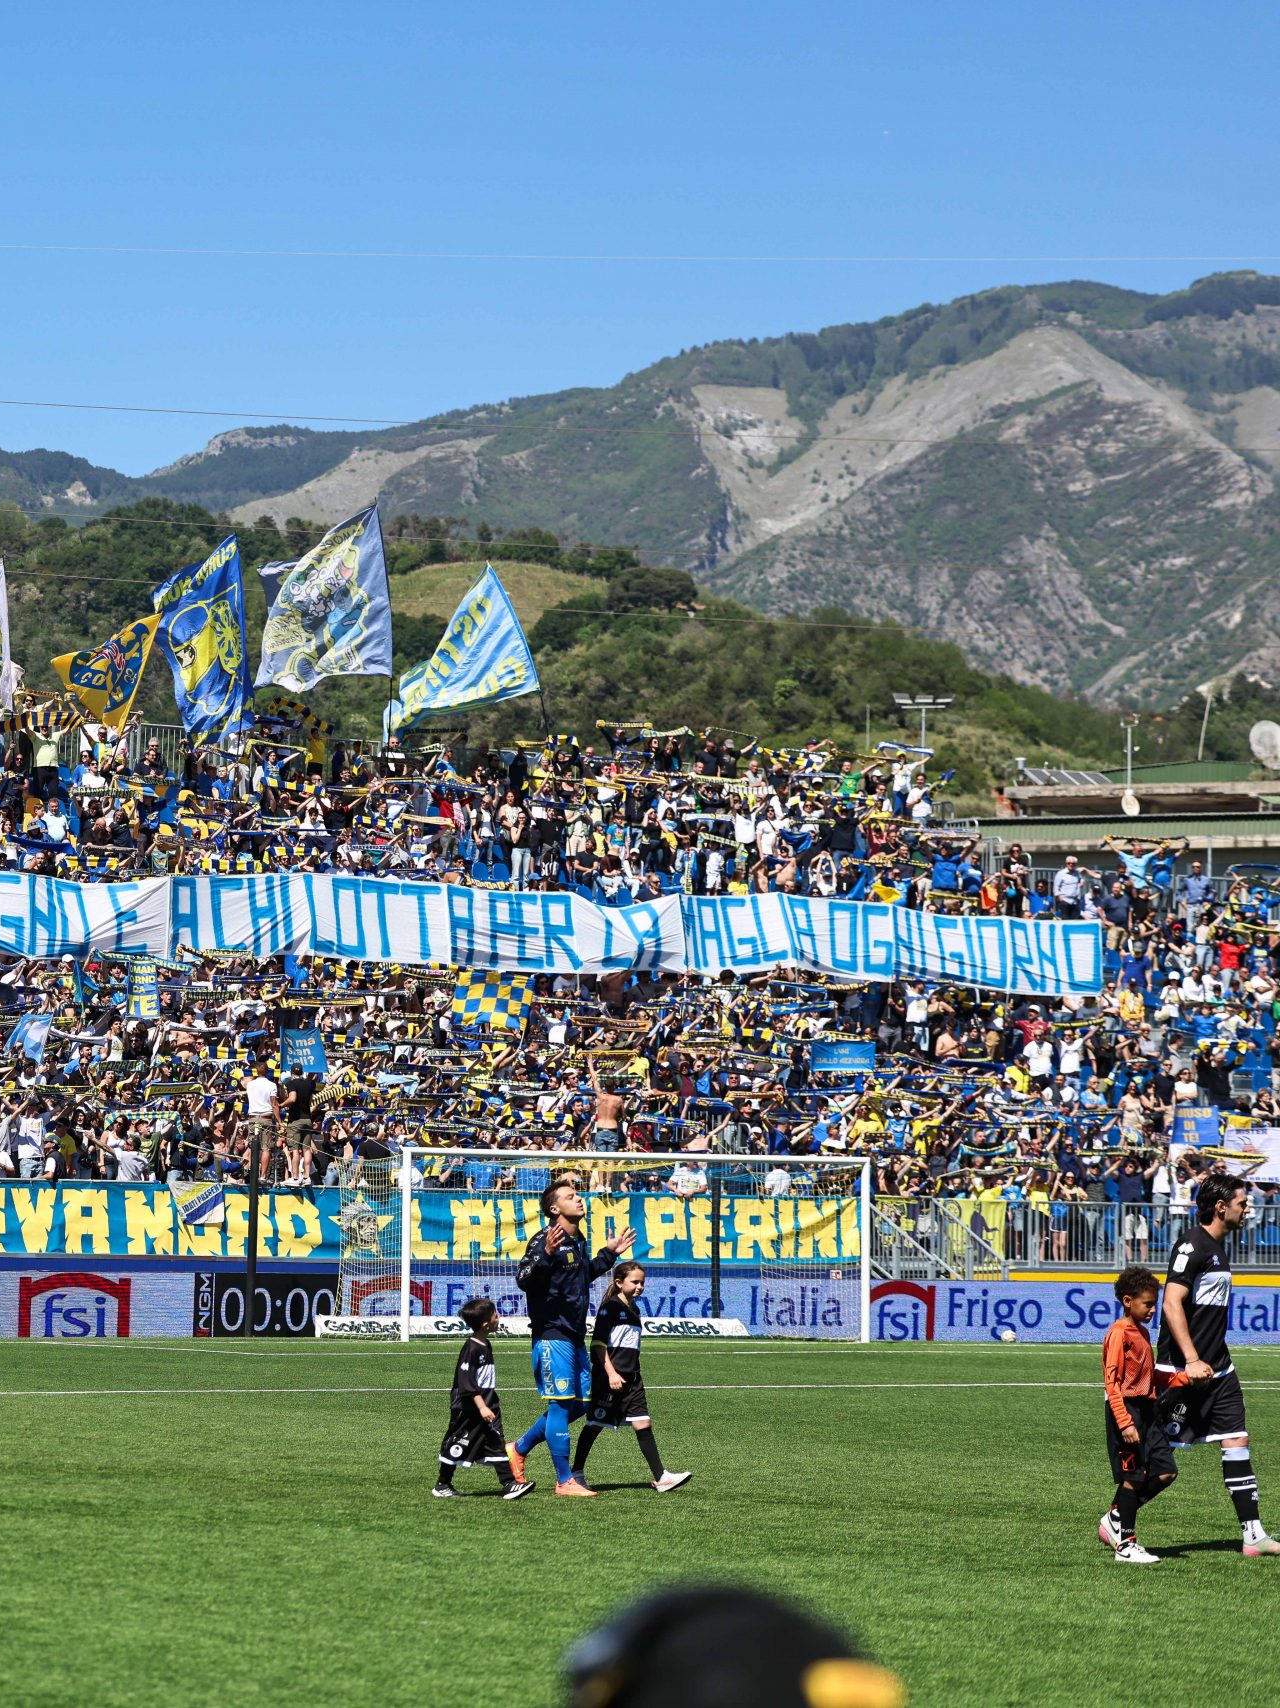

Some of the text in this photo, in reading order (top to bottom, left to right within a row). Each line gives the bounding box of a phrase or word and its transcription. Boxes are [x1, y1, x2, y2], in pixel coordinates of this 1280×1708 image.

[107, 884, 147, 954] E
[170, 876, 200, 959] A
[209, 875, 293, 957] CHI
[303, 874, 474, 967] LOTTA
[487, 892, 583, 970] PER
[596, 903, 663, 970] LA
[934, 914, 1101, 993] GIORNO
[128, 995, 158, 1016] TE
[411, 1197, 631, 1259] LAUO
[43, 1294, 106, 1338] fsi
[324, 1319, 402, 1334] GoldBet
[749, 1285, 843, 1327] Italia
[877, 1299, 920, 1341] fsi
[948, 1287, 1043, 1340] Frigo
[1227, 1287, 1280, 1331] Ital
[644, 1320, 720, 1336] GoldBet
